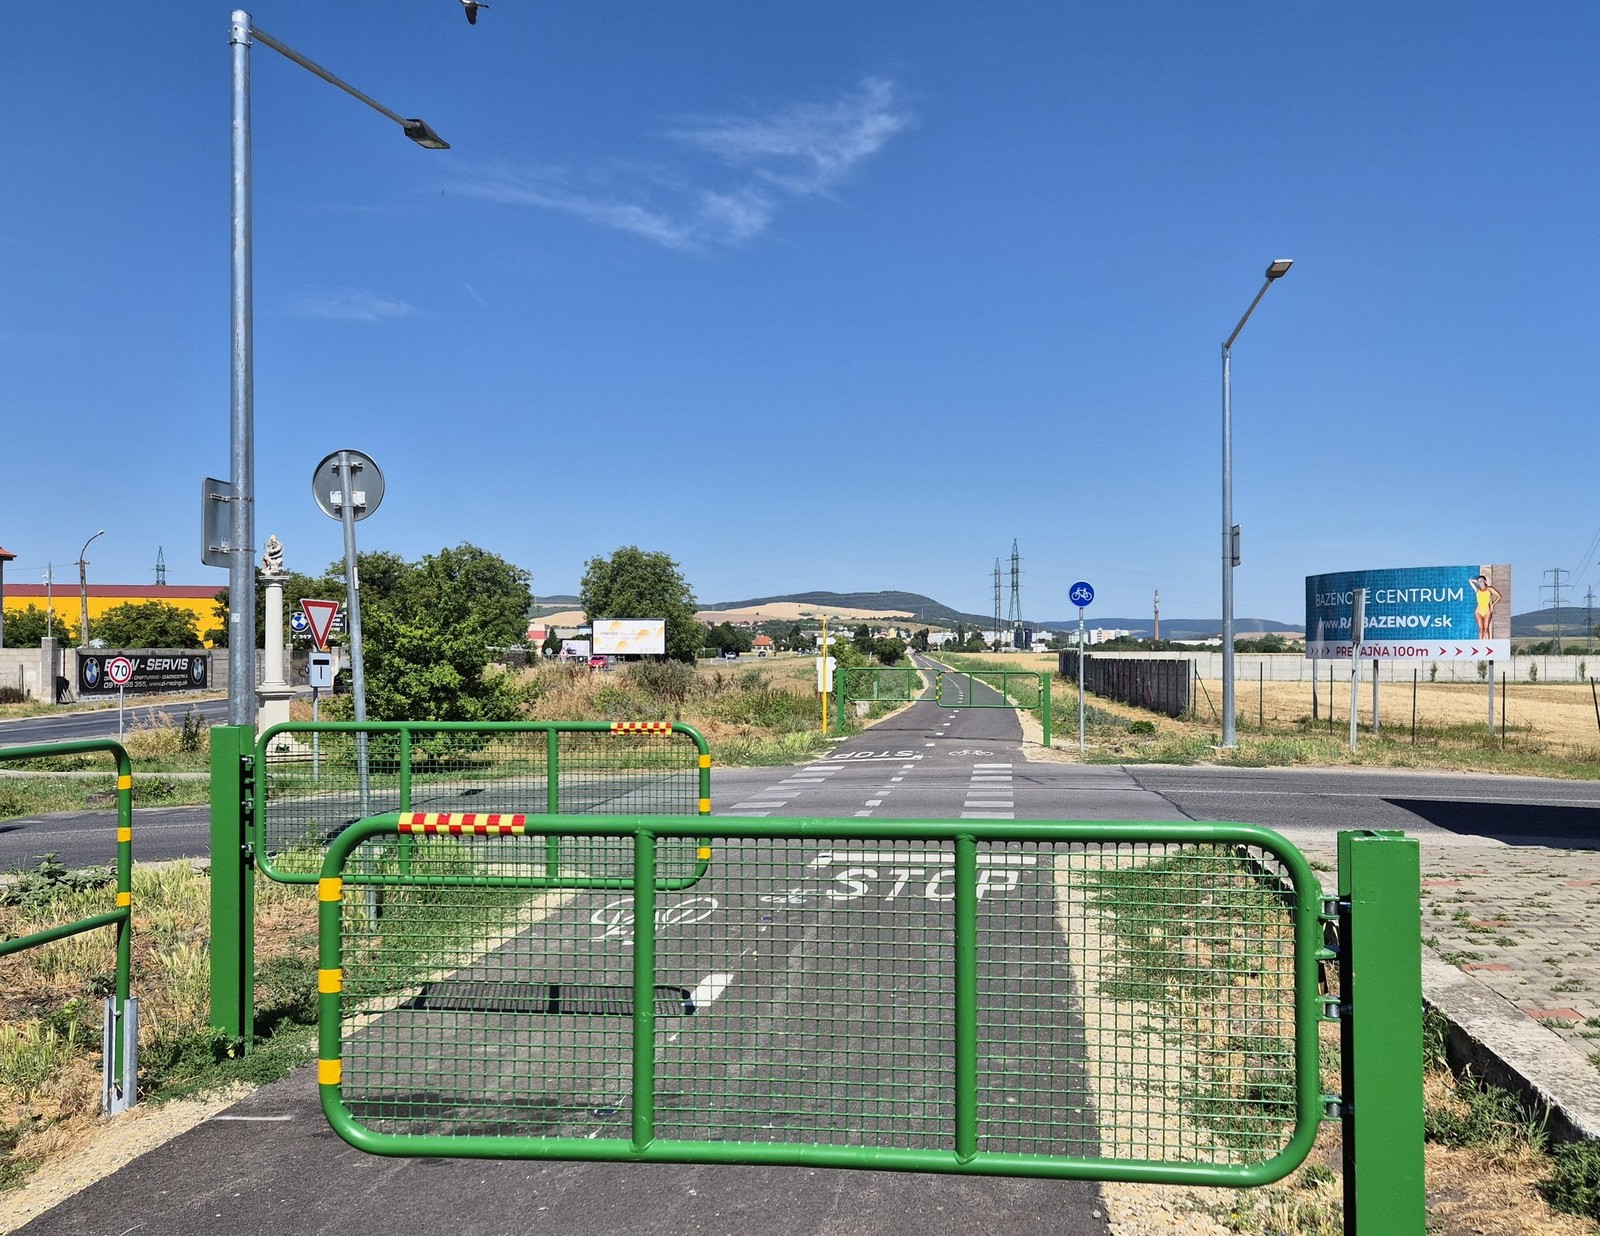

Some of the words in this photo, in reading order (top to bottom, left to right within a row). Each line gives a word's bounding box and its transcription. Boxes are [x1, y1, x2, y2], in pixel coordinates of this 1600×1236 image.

[1315, 587, 1371, 607] BAZÉNOÉ
[1375, 587, 1464, 605] CENTRUM
[1336, 643, 1390, 657] PREAJŇA
[1393, 646, 1429, 657] 100m
[114, 665, 128, 677] 70
[146, 658, 189, 671] SERVIS
[832, 750, 914, 759] STOP
[826, 868, 1019, 901] STOP
